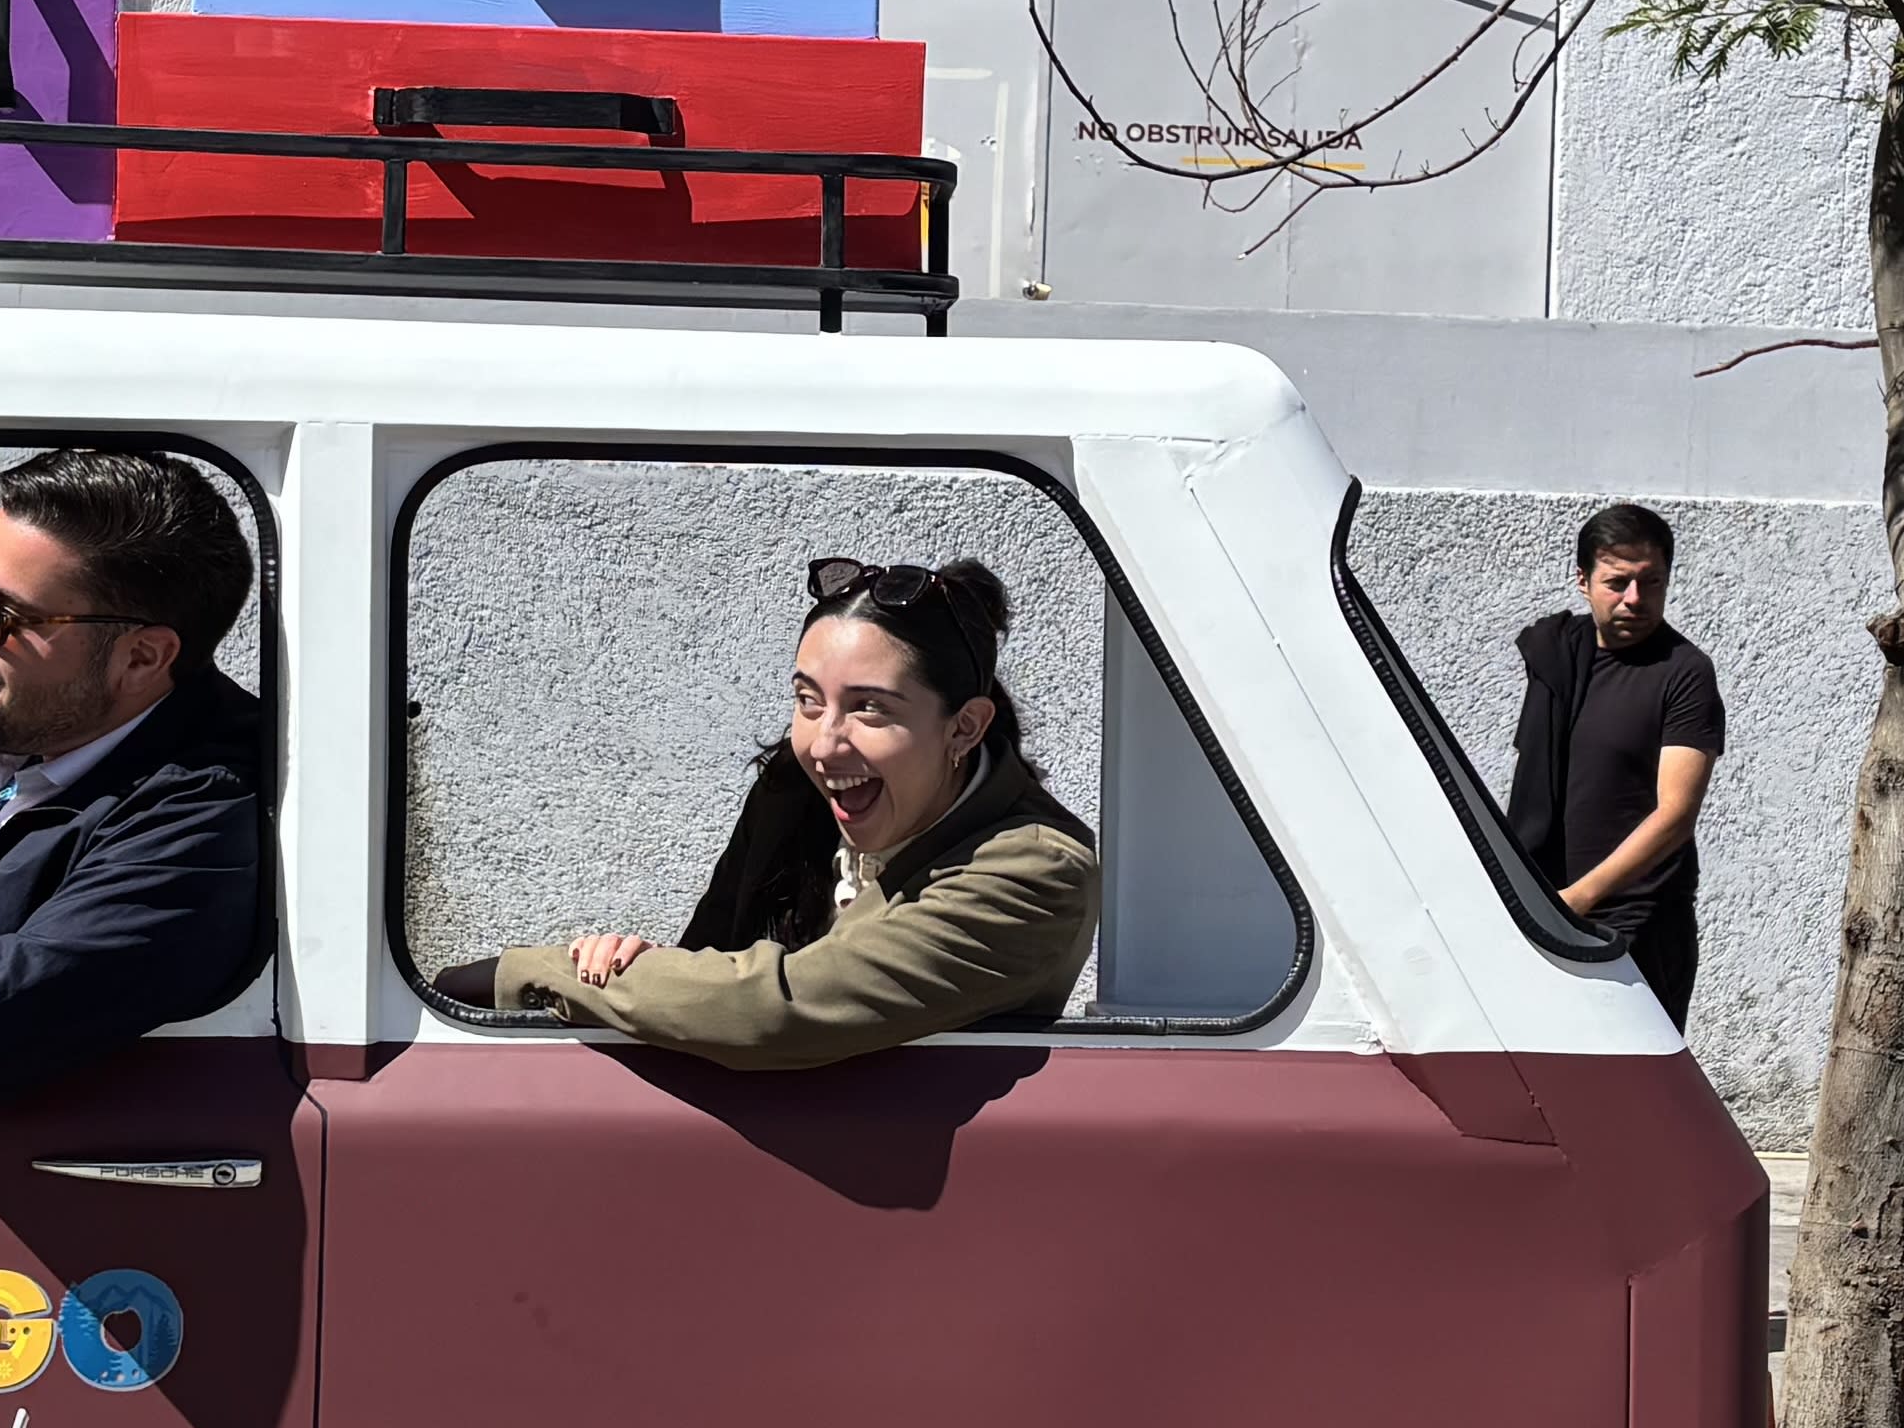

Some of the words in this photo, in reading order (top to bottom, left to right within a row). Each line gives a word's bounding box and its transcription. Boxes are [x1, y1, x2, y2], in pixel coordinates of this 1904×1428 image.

[1078, 121, 1118, 141] NO
[1126, 123, 1260, 147] OBSTRUIR
[1267, 128, 1363, 151] SALIDA
